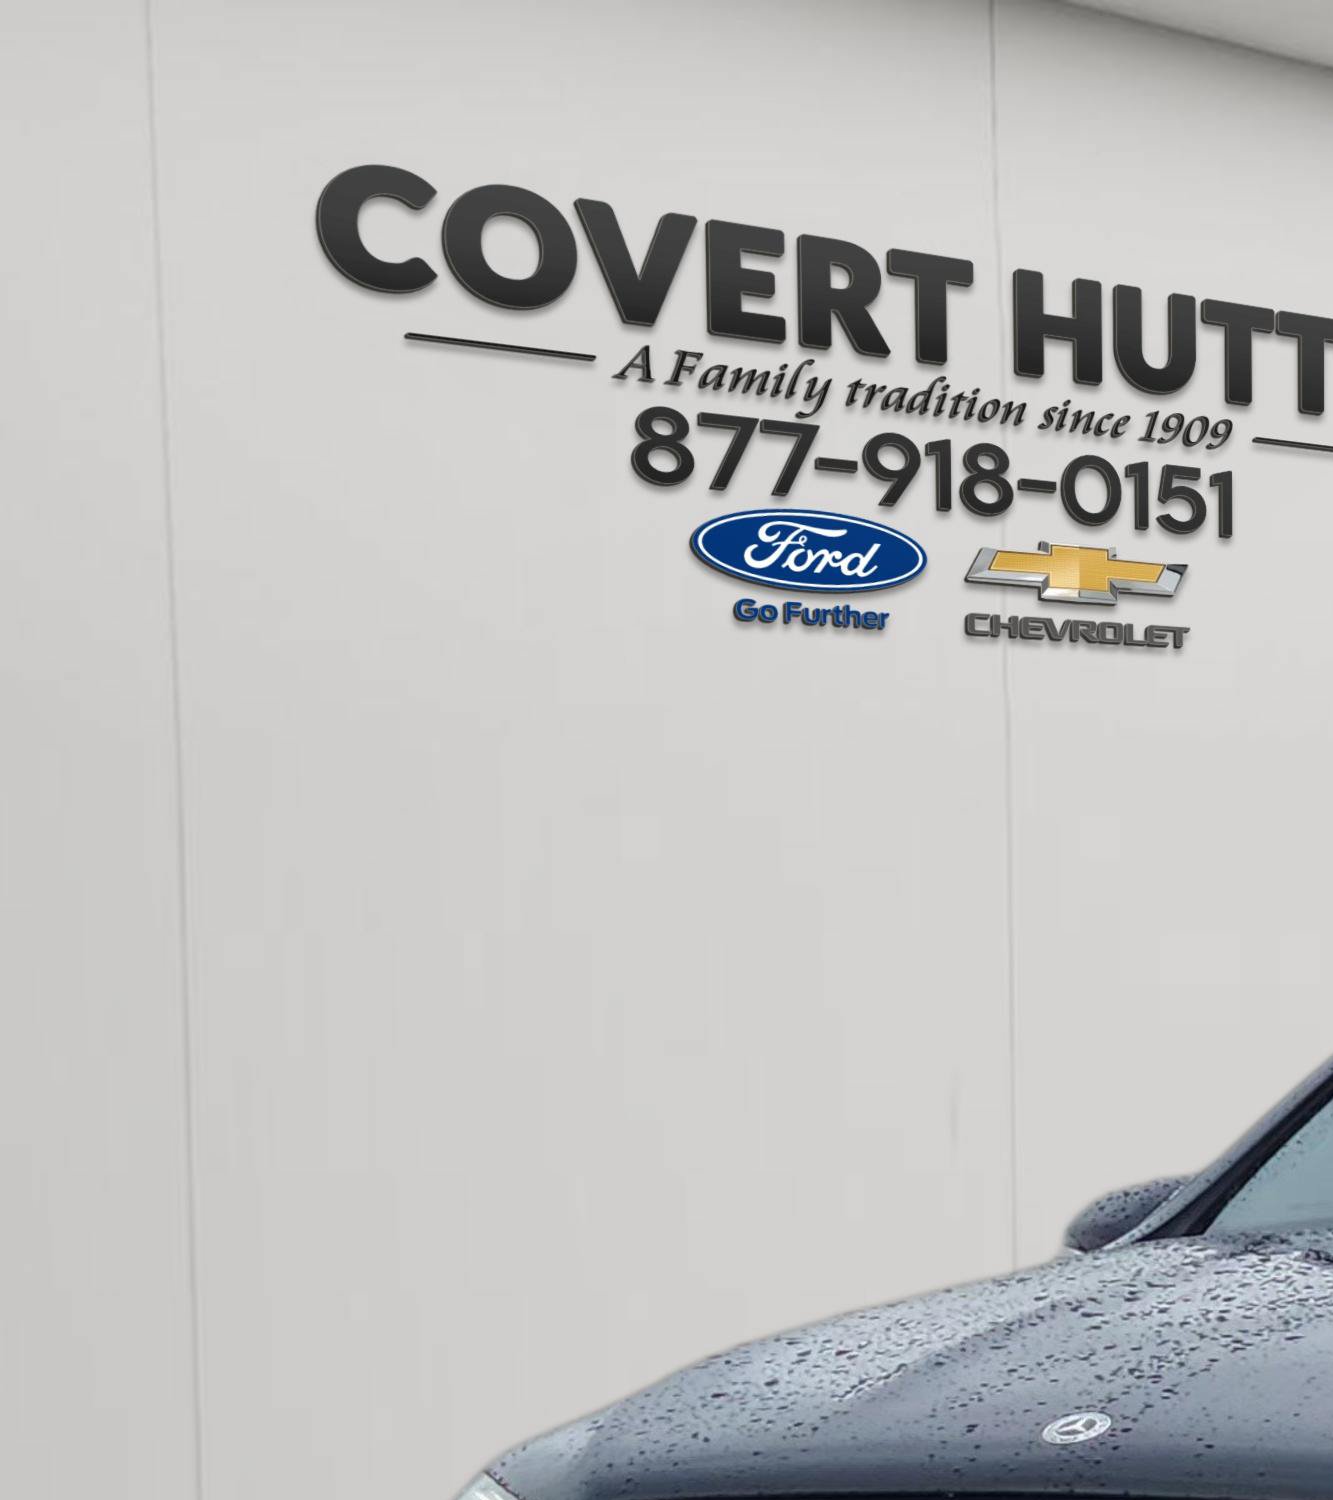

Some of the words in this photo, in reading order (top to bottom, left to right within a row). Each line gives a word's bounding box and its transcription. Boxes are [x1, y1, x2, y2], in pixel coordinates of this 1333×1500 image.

[316, 164, 974, 368] COVERT
[611, 344, 656, 385] A
[662, 347, 834, 420] Family
[845, 374, 1028, 427] tradition
[1037, 396, 1132, 440] since
[1137, 409, 1235, 452] 1909
[630, 406, 1234, 541] 877-918-0151
[743, 518, 880, 583] Ford
[732, 598, 780, 626] Go
[782, 601, 891, 632] Further
[963, 611, 1192, 651] CHEVROLET
